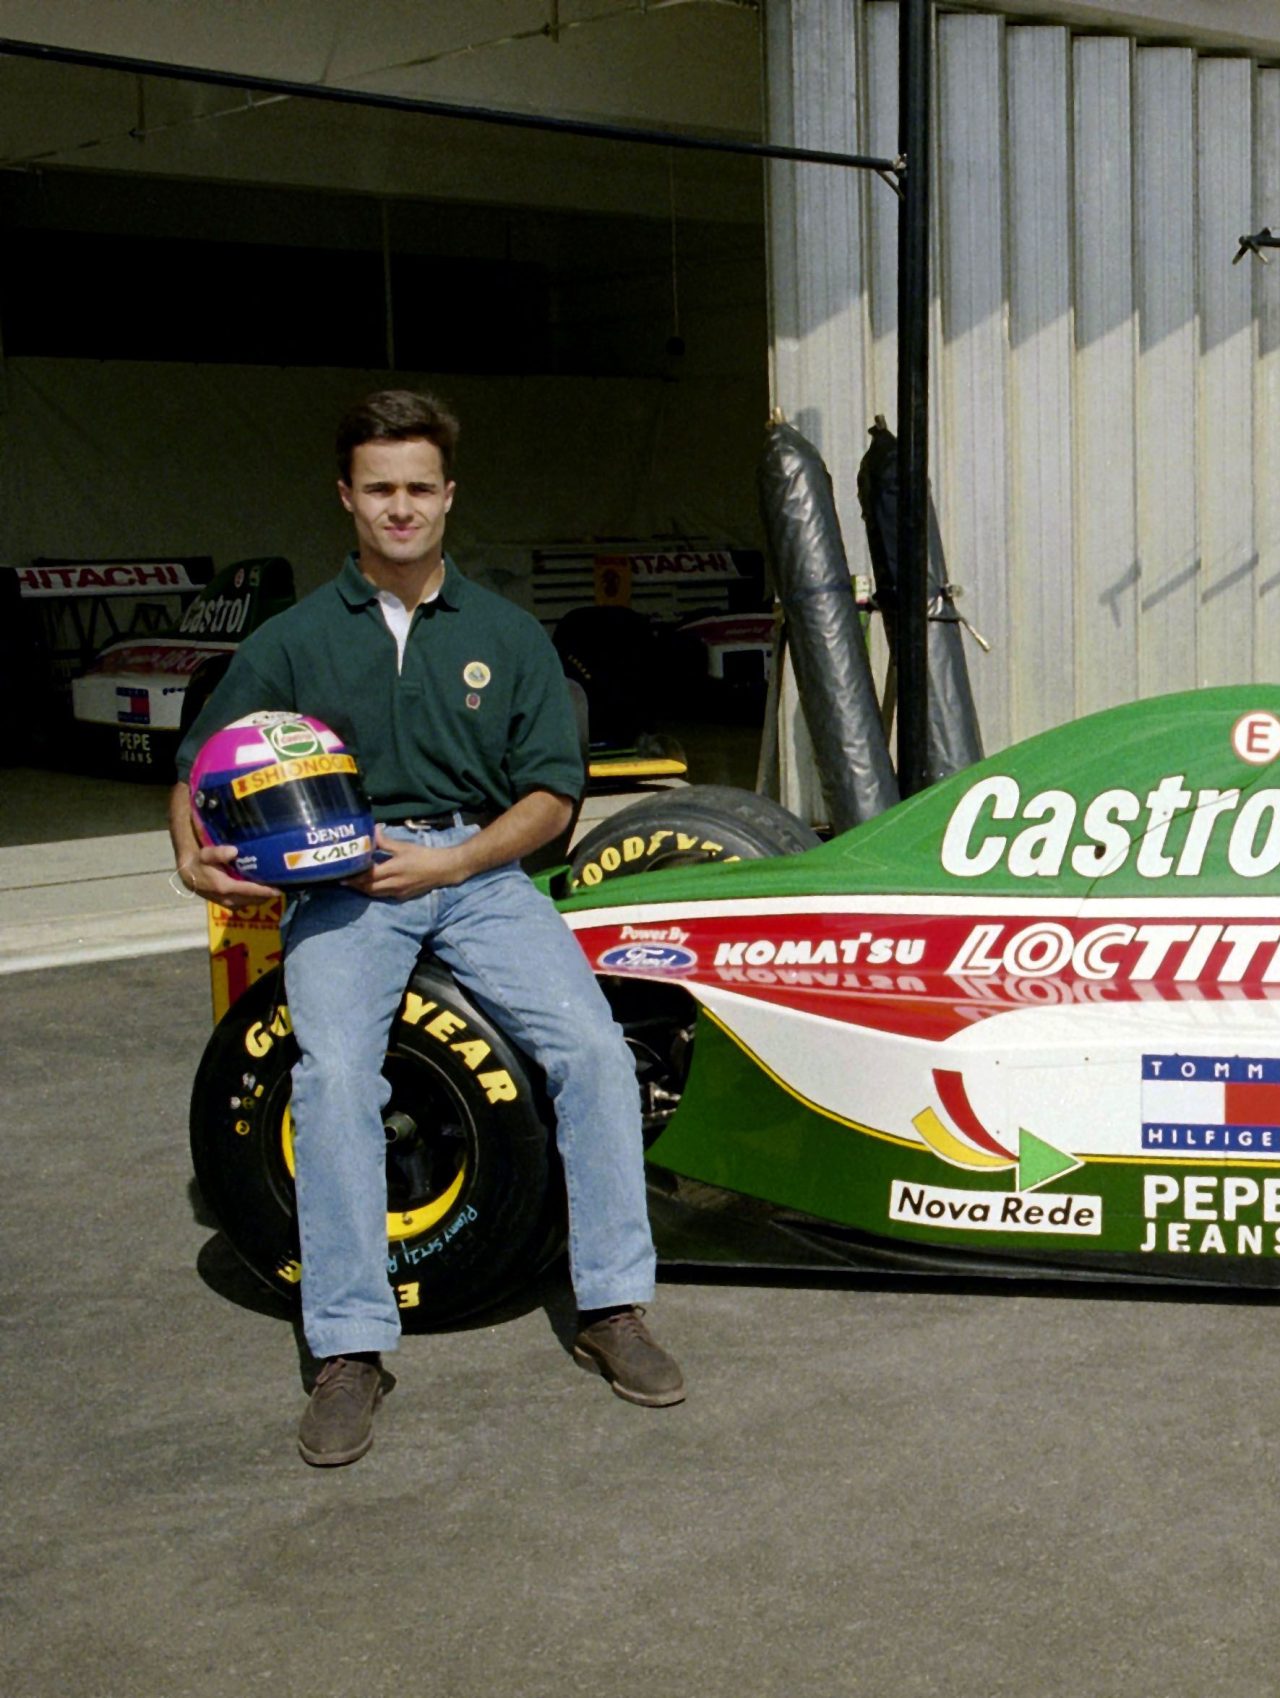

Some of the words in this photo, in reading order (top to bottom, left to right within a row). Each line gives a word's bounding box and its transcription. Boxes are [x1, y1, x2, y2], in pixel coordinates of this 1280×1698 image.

[17, 565, 181, 590] HITACHI
[629, 551, 728, 574] ITACHI
[180, 594, 250, 633] Castrol
[1246, 720, 1272, 753] E
[306, 824, 355, 845] DENIM
[713, 932, 926, 967] KOMATSU
[898, 1188, 997, 1223] Nova
[1001, 1198, 1095, 1228] Rede
